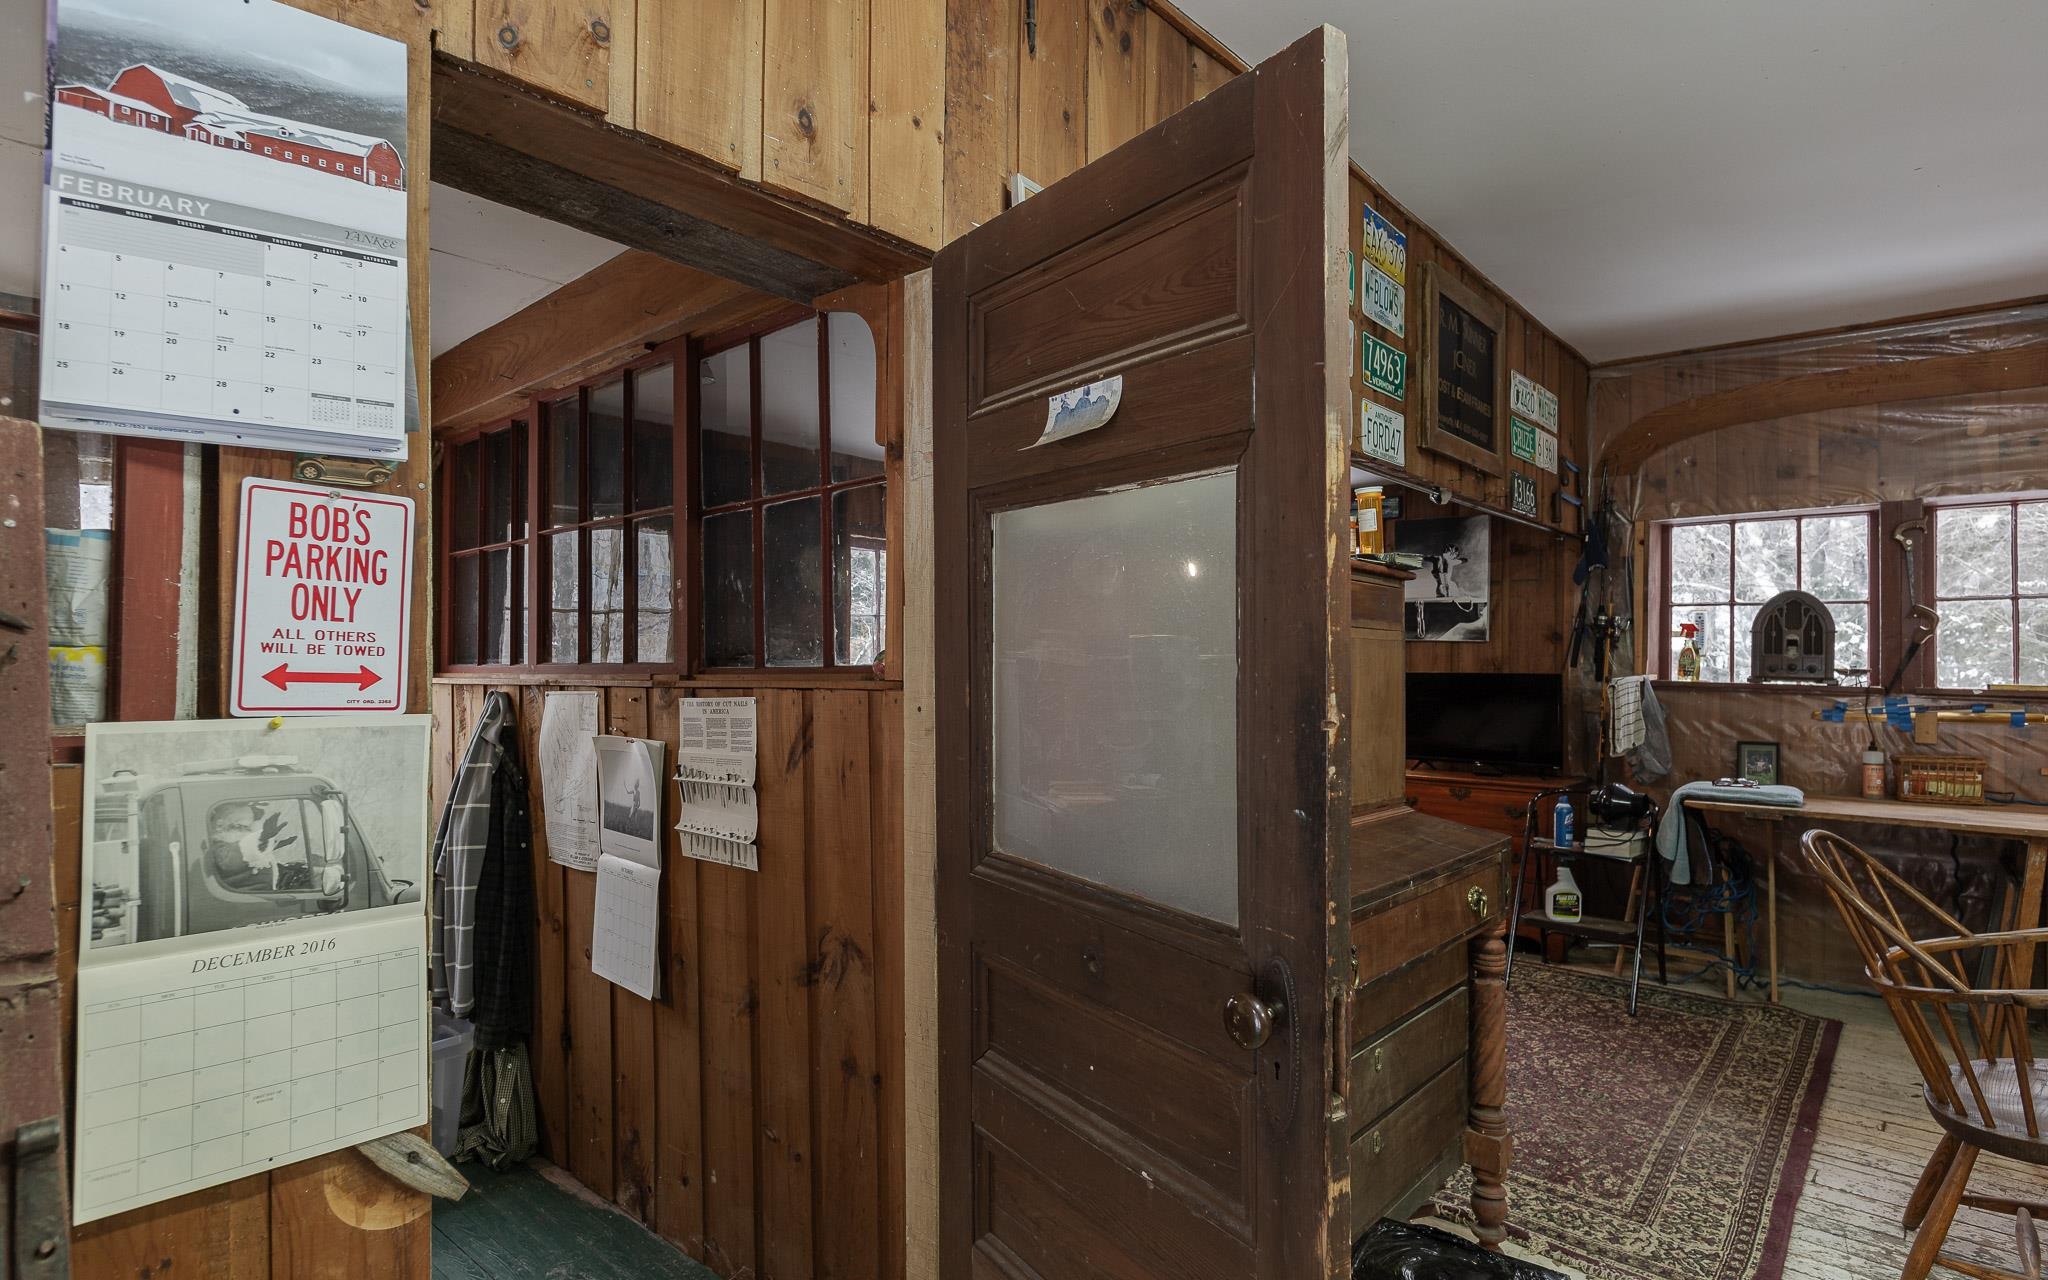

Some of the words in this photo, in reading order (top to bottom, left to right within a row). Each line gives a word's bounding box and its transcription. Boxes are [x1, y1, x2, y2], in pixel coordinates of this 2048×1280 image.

[58, 173, 211, 217] FEBRUARY
[72, 200, 100, 210] SUNDAY
[126, 210, 153, 220] MONDAY
[177, 219, 206, 230] TUESDAY
[222, 228, 258, 240] WEDNESDAY
[272, 238, 302, 248] THURSDAY
[322, 247, 344, 256] FRIDAY
[362, 255, 391, 265] SATURDAY
[344, 230, 400, 250] YANKEE
[1366, 339, 1401, 385] 74963
[1372, 375, 1395, 393] VERMONT
[1375, 411, 1392, 425] ANTIQUE
[1513, 426, 1534, 453] CRUZE
[1514, 478, 1535, 507] A3166
[289, 501, 372, 546] BOB'S
[265, 539, 388, 586] PARKING
[291, 582, 362, 623] ONLY
[260, 642, 299, 654] WILL
[307, 643, 326, 655] BE
[335, 645, 385, 657] TOWED
[272, 628, 305, 641] ALL
[314, 629, 376, 643] OTHERS
[191, 945, 295, 974] DECEMBER
[300, 937, 336, 955] 2016
